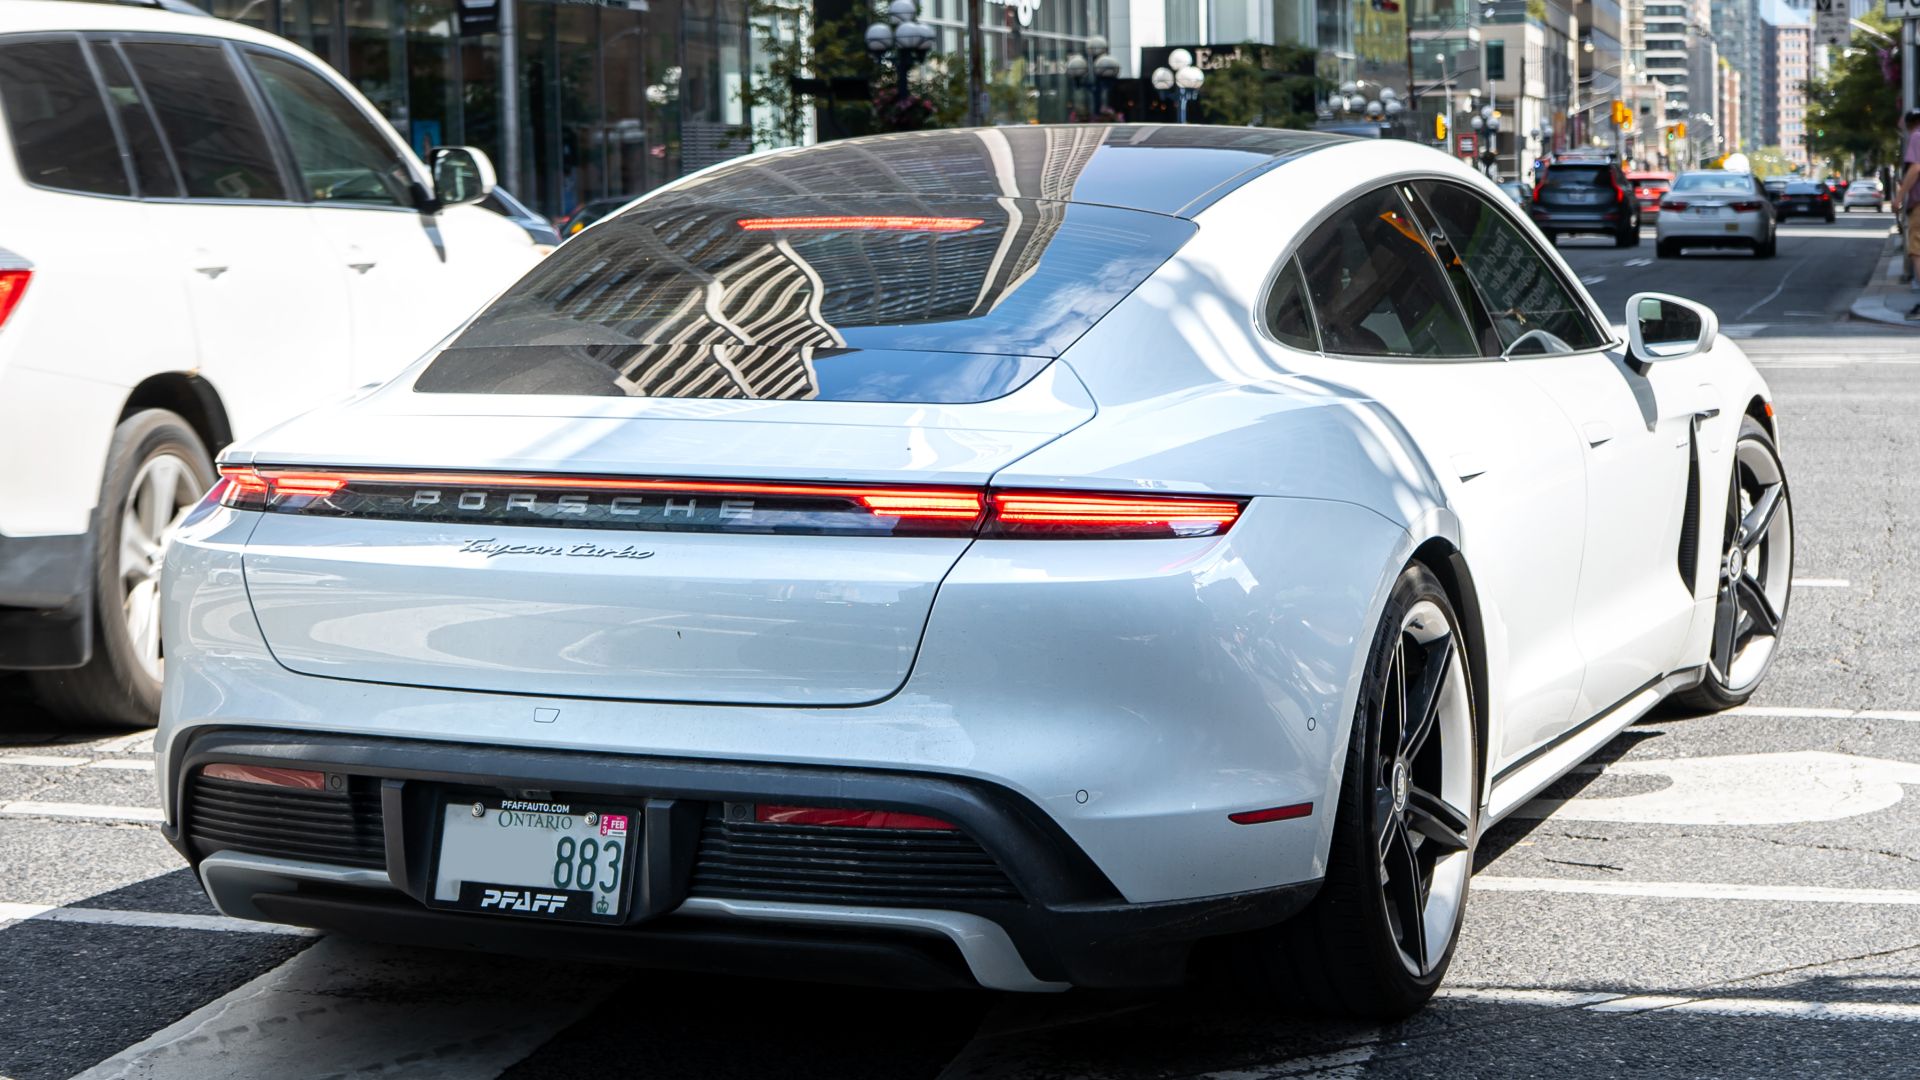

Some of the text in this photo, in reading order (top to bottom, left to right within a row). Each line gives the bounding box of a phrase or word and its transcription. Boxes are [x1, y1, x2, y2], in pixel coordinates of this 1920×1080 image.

[412, 490, 755, 520] PORSCHE
[459, 538, 562, 558] Taycan
[501, 800, 570, 813] PFAFFAUTO.COM
[611, 820, 625, 829] FEB
[553, 836, 622, 893] 883
[481, 889, 568, 913] PFAFF
